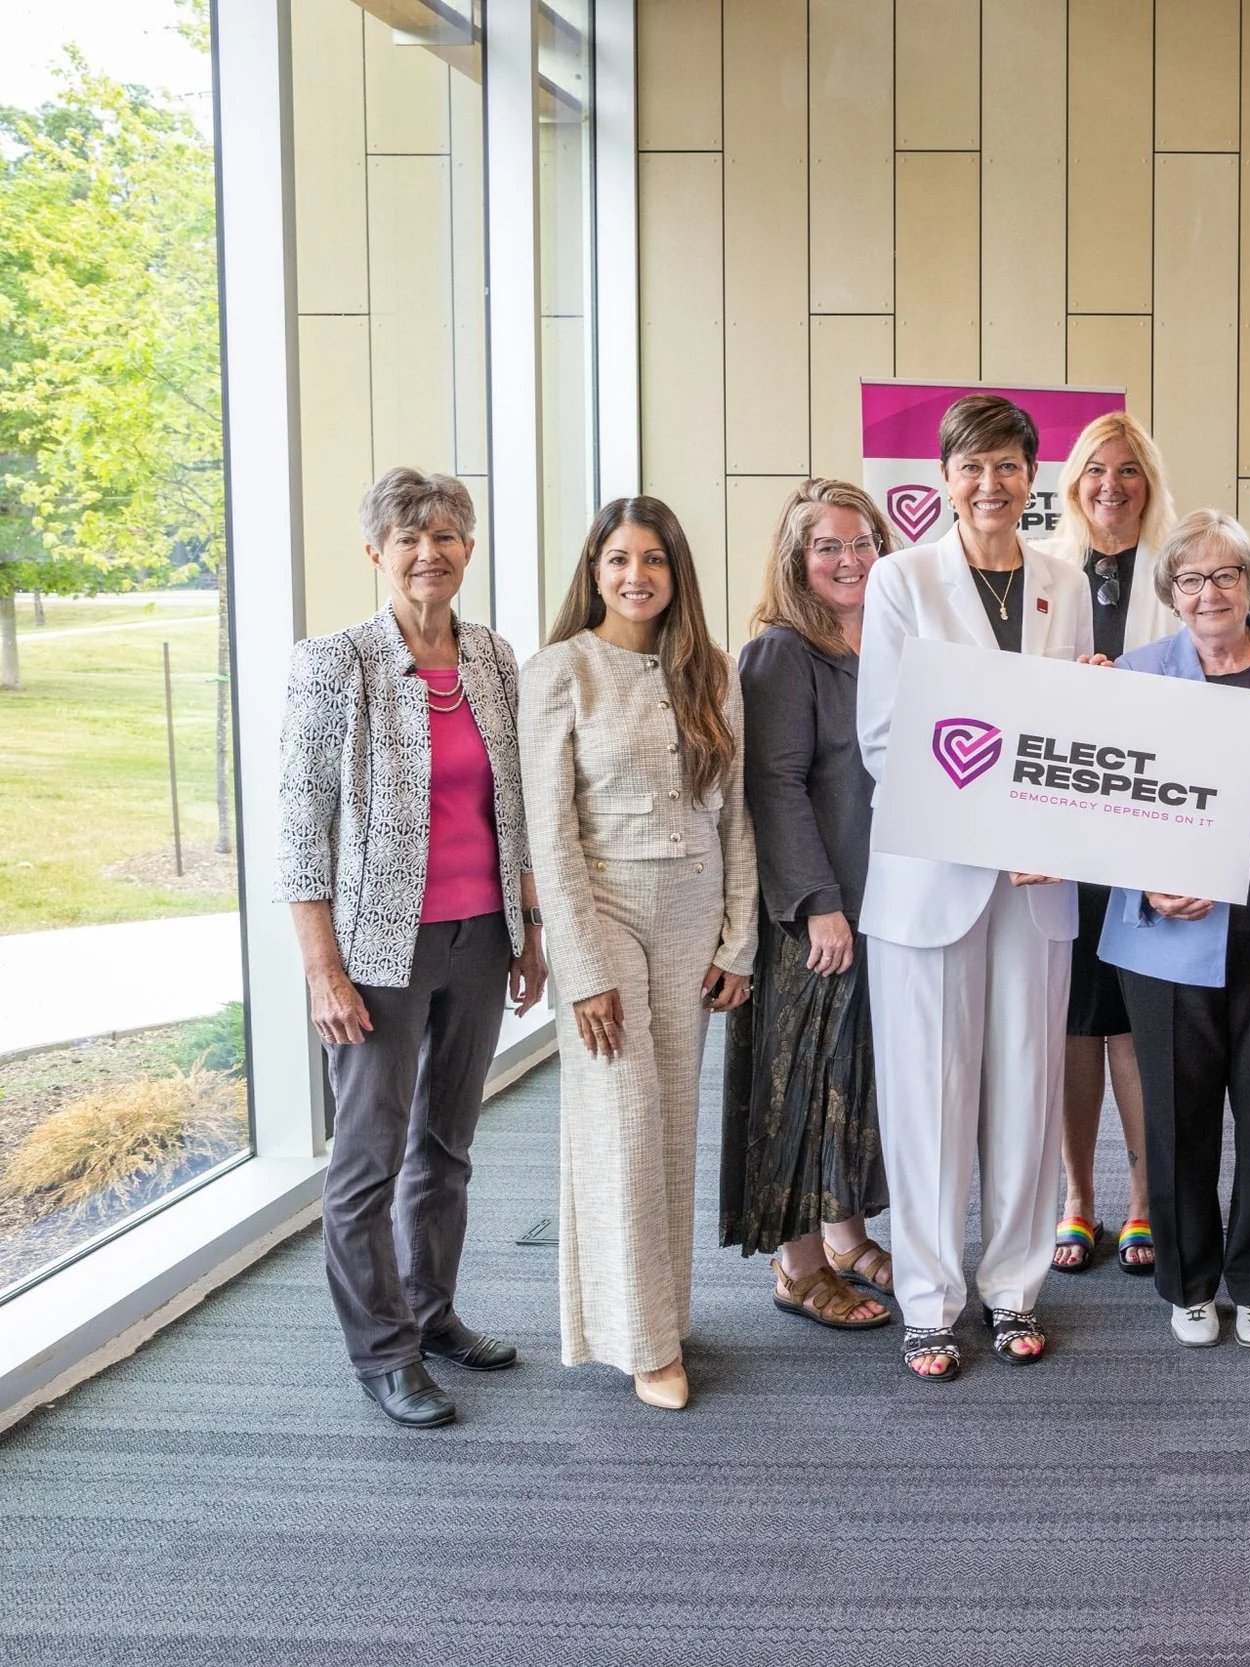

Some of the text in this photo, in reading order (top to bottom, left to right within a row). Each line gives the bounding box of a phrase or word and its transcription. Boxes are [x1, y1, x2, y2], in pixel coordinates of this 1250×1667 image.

[1016, 733, 1157, 776] ELECT
[1012, 759, 1219, 811] RESPECT
[1009, 790, 1214, 827] DEMOCRACY DEPENDS ON IT
